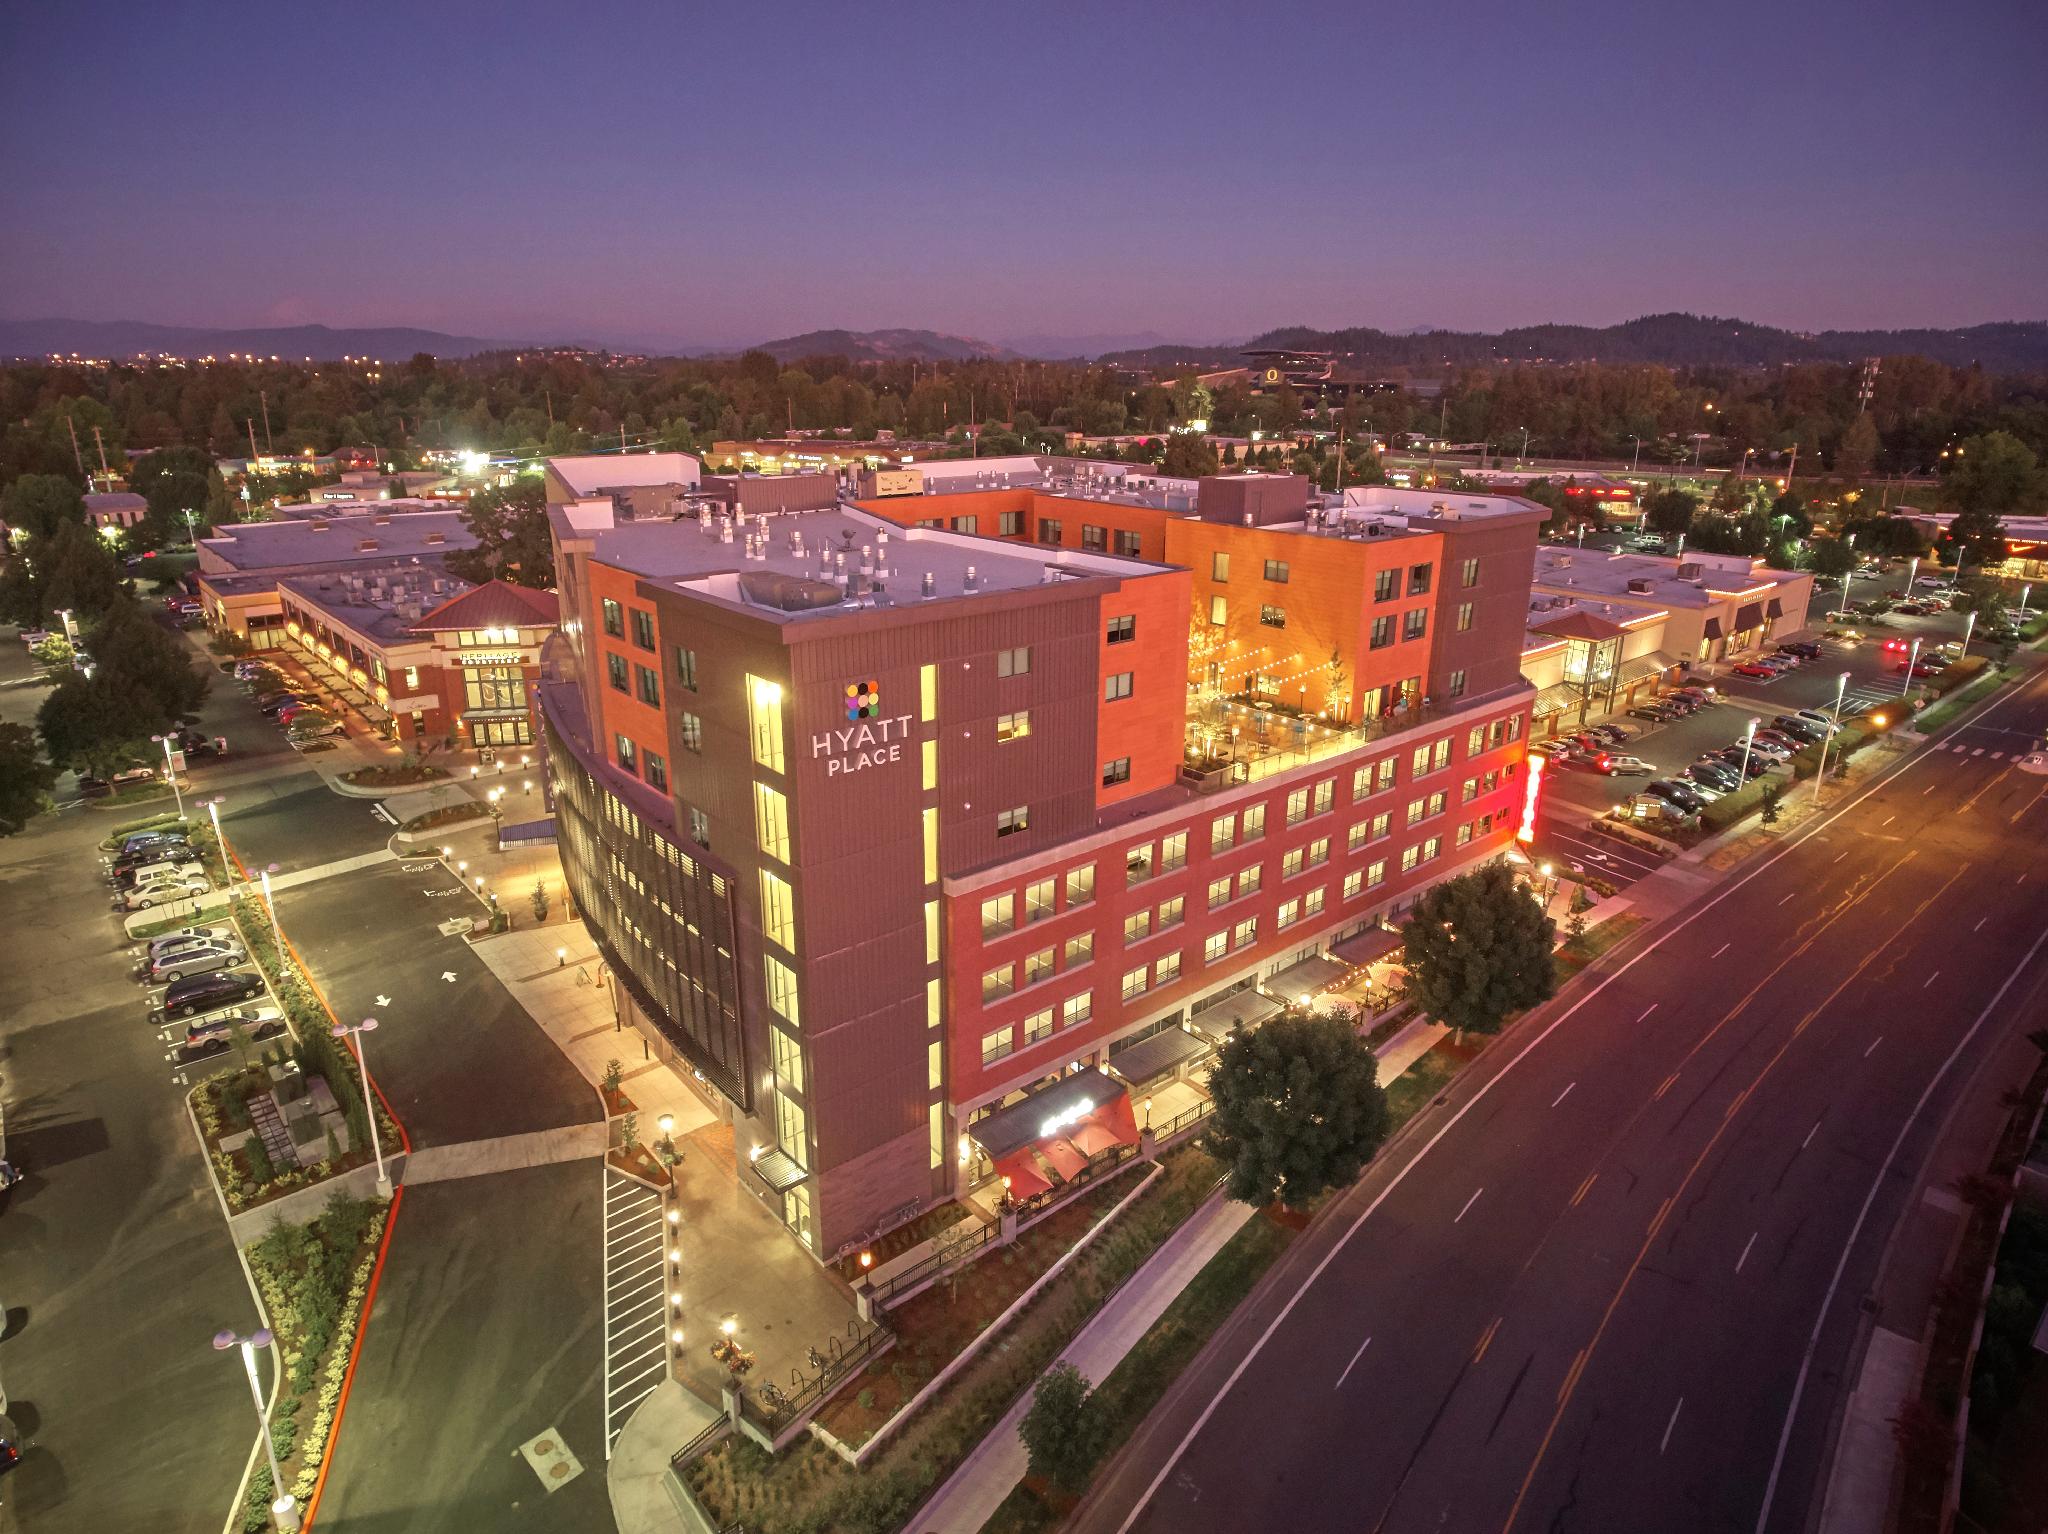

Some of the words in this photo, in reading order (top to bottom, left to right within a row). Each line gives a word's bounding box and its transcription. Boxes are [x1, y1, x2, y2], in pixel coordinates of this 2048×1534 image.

[461, 651, 518, 659] HERITAGE
[812, 714, 913, 759] HYATT
[828, 745, 901, 777] PLACE
